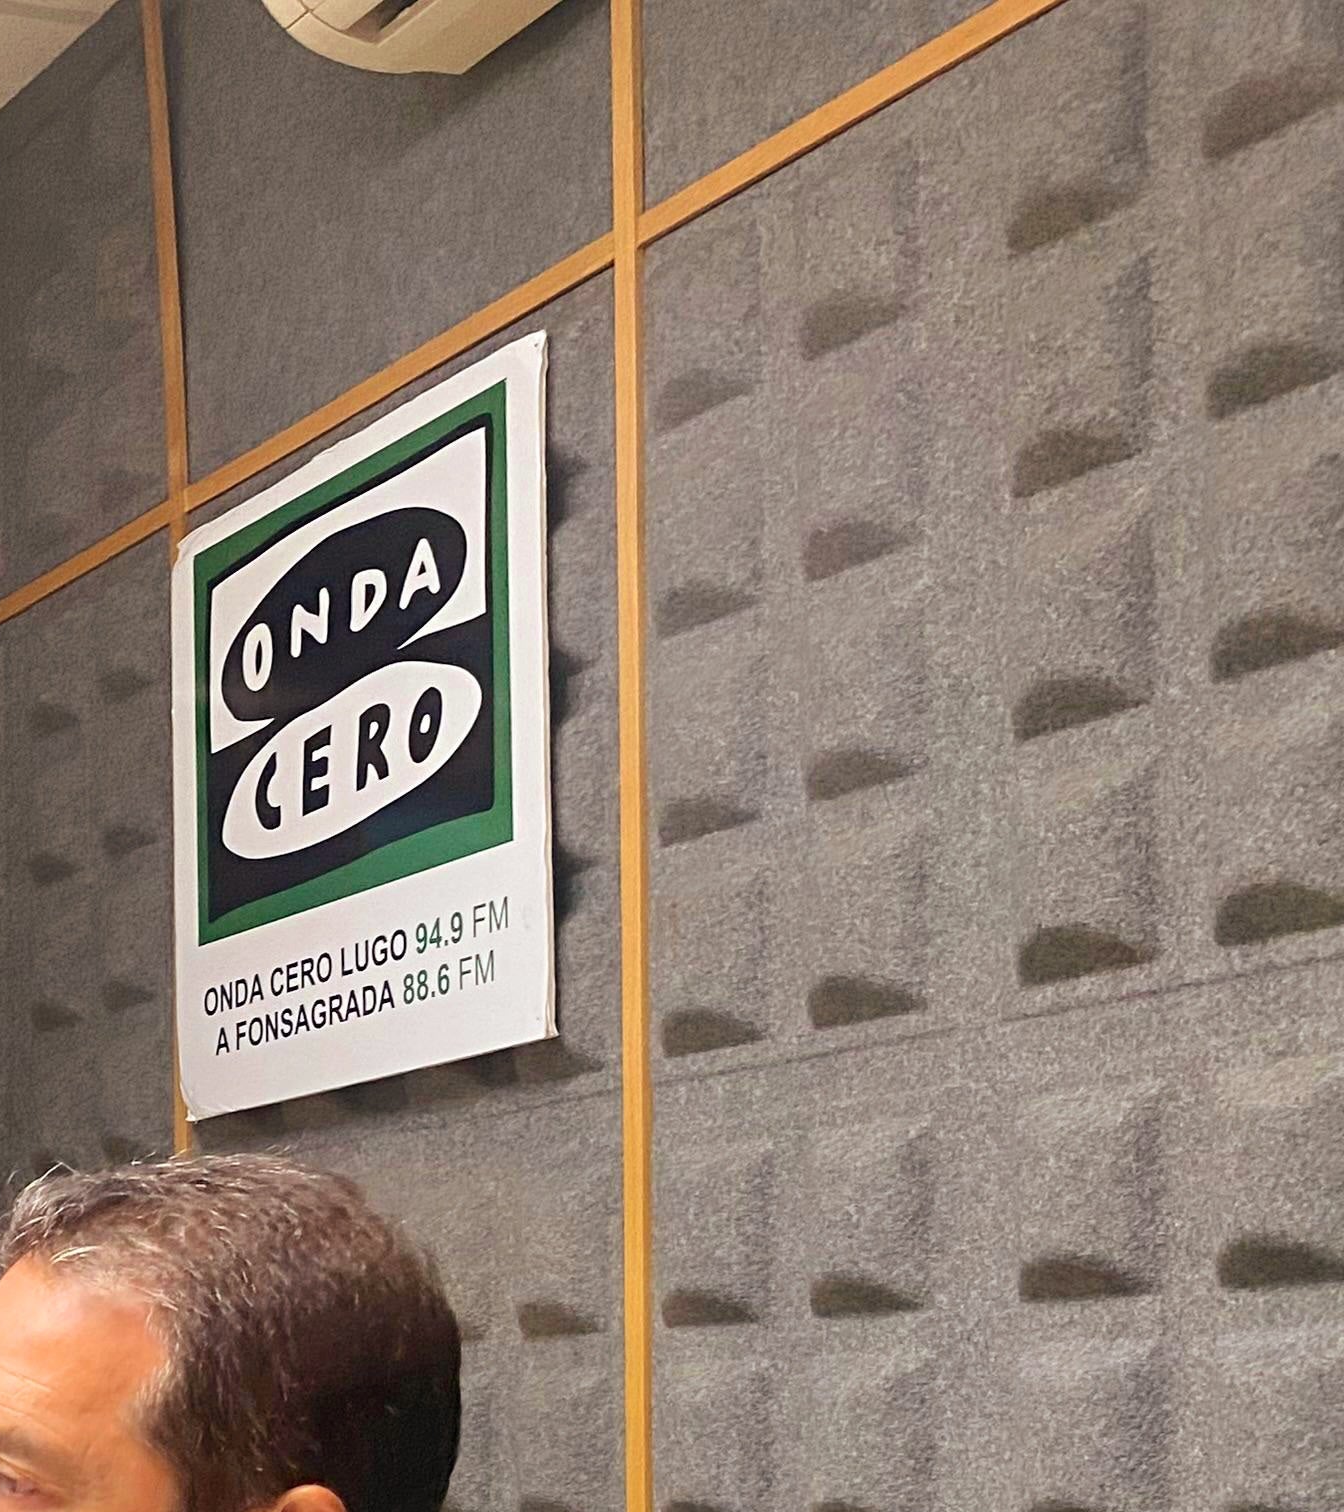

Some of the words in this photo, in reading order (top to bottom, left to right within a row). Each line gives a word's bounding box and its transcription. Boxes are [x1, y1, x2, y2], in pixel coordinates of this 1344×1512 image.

[242, 538, 440, 692] ONDA
[255, 687, 443, 830] CERO
[204, 974, 264, 1016] ONDA
[270, 953, 332, 997] CERO
[341, 929, 407, 977] LUGO
[416, 912, 463, 954] 94.9
[473, 896, 509, 938] FM
[216, 1027, 230, 1056] A
[236, 980, 395, 1050] FONSAGRADA
[403, 964, 450, 1004] 88.6
[459, 950, 495, 990] FM
